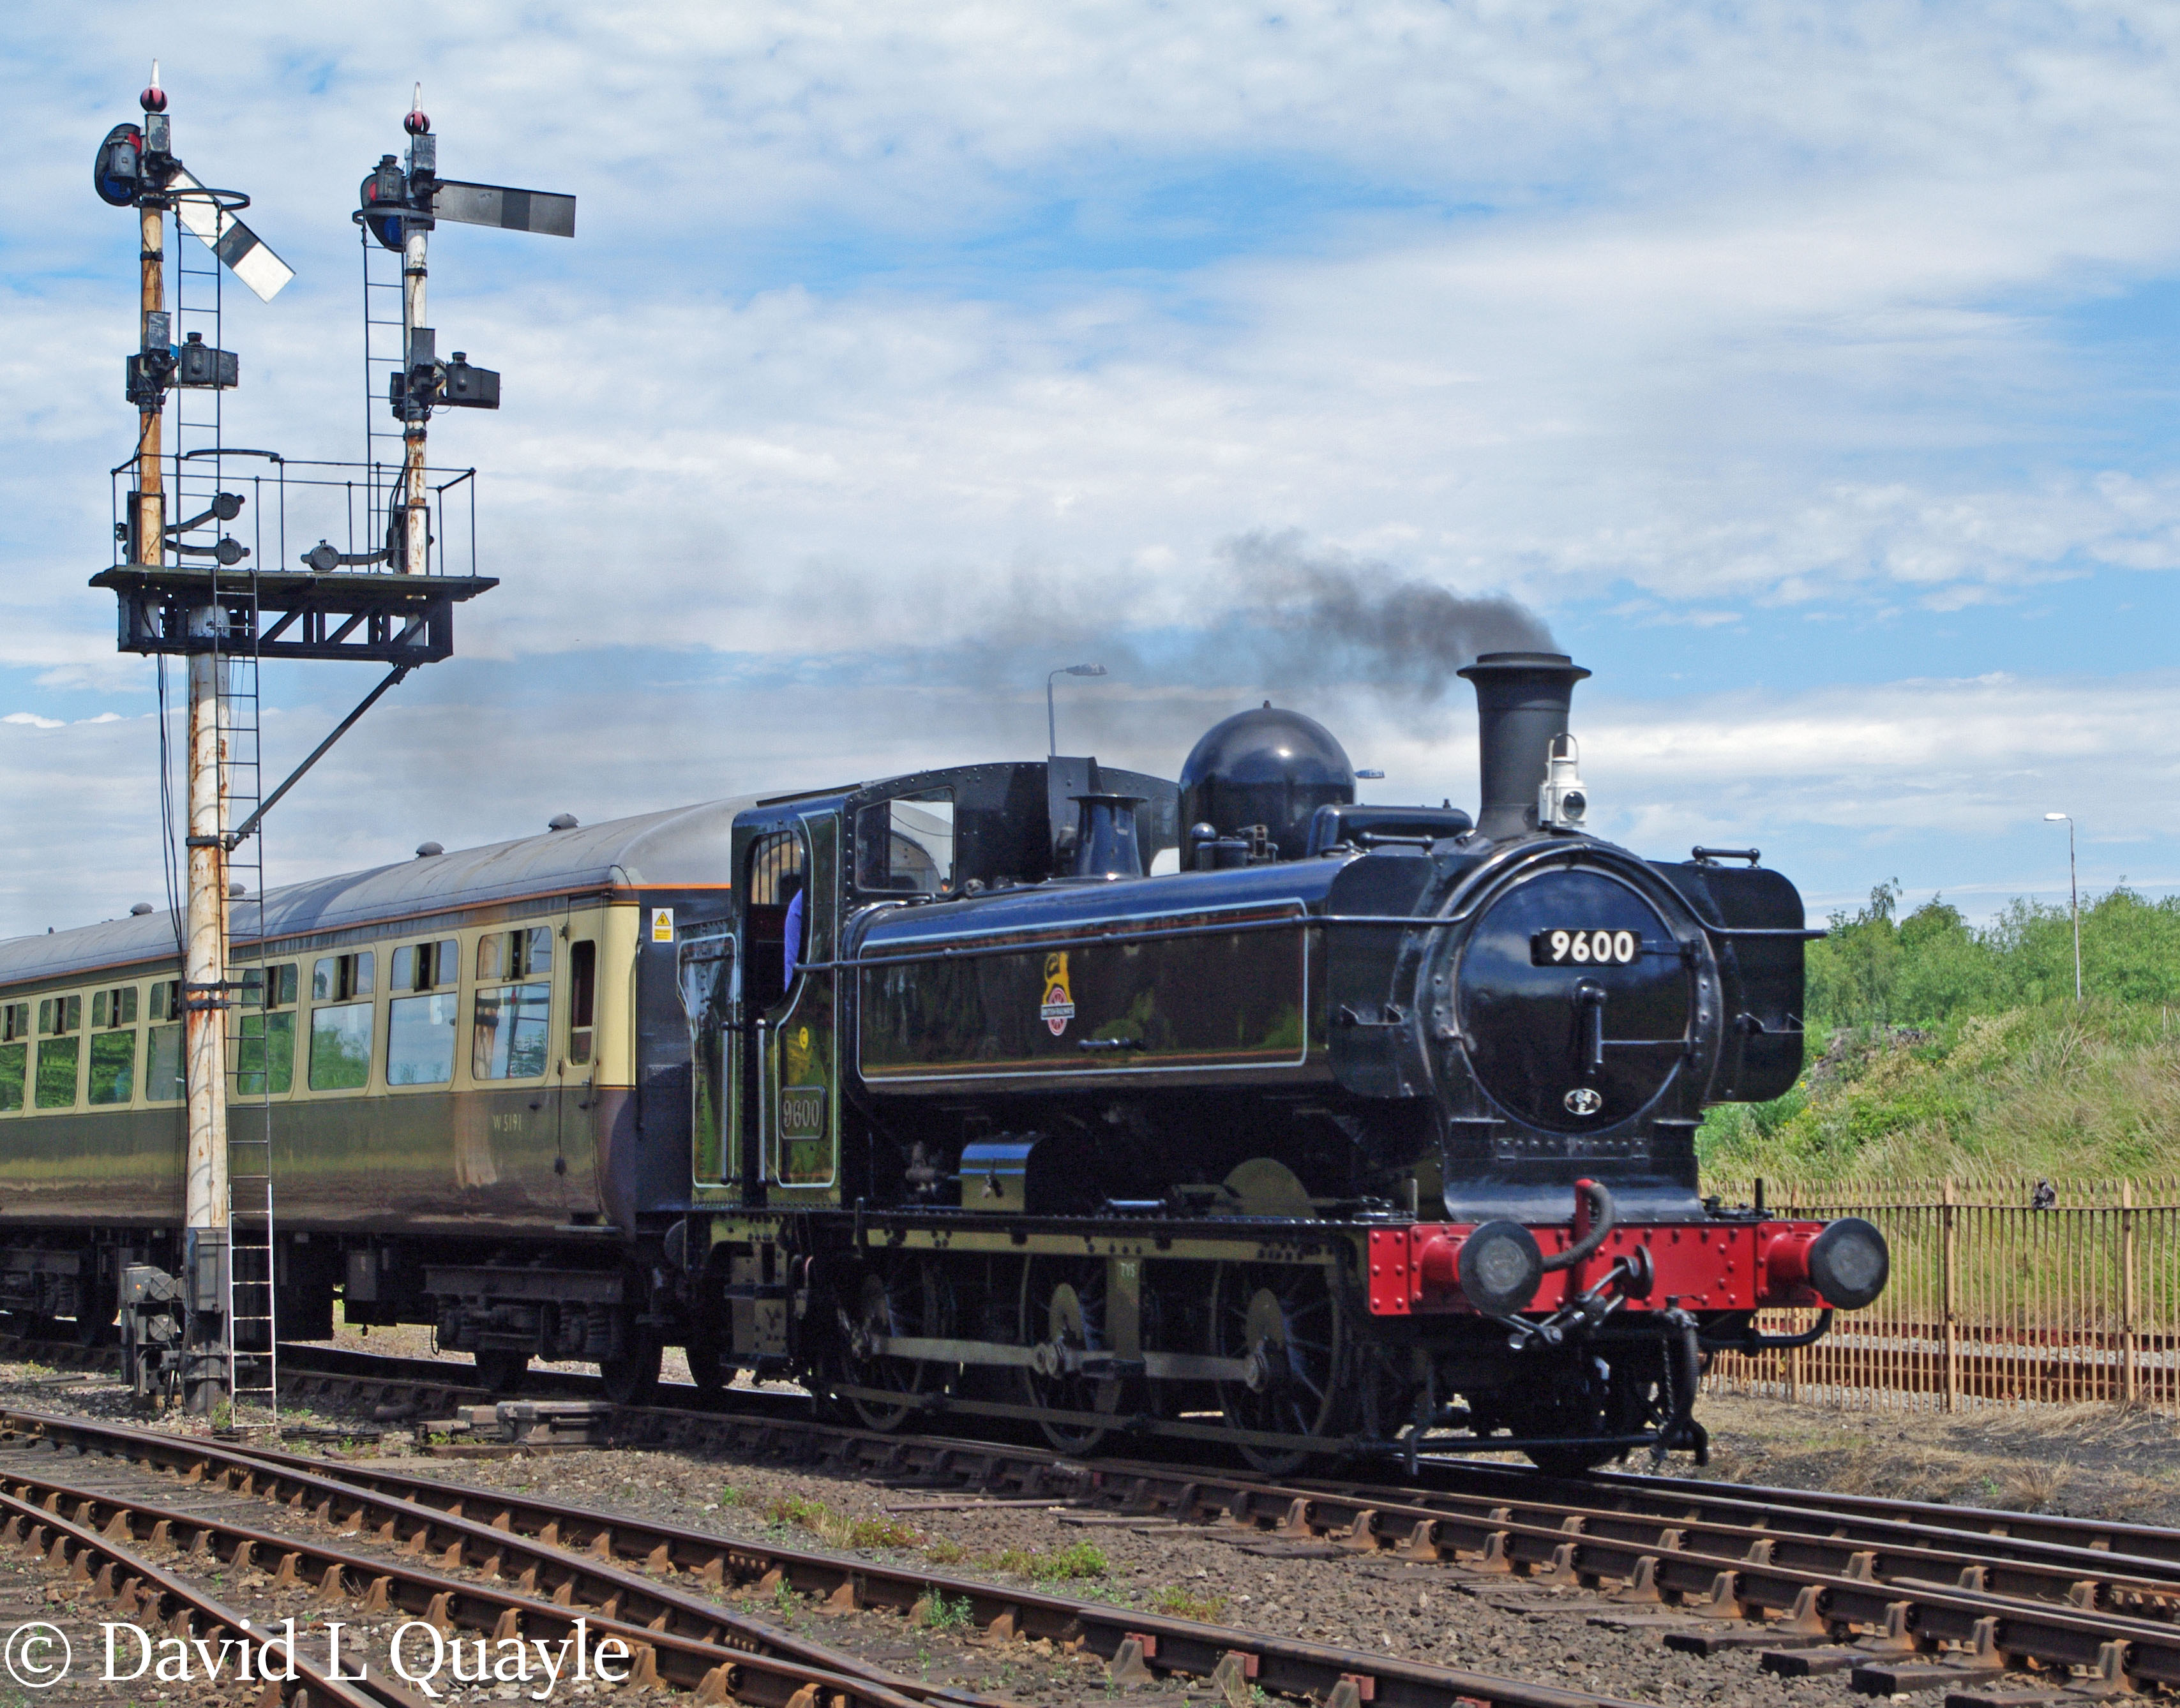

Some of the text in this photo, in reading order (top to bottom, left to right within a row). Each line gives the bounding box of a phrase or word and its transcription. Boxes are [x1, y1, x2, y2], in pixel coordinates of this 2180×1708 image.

[1551, 931, 1634, 963] 9600
[492, 1114, 522, 1132] W 5191
[783, 1100, 820, 1128] 9600
